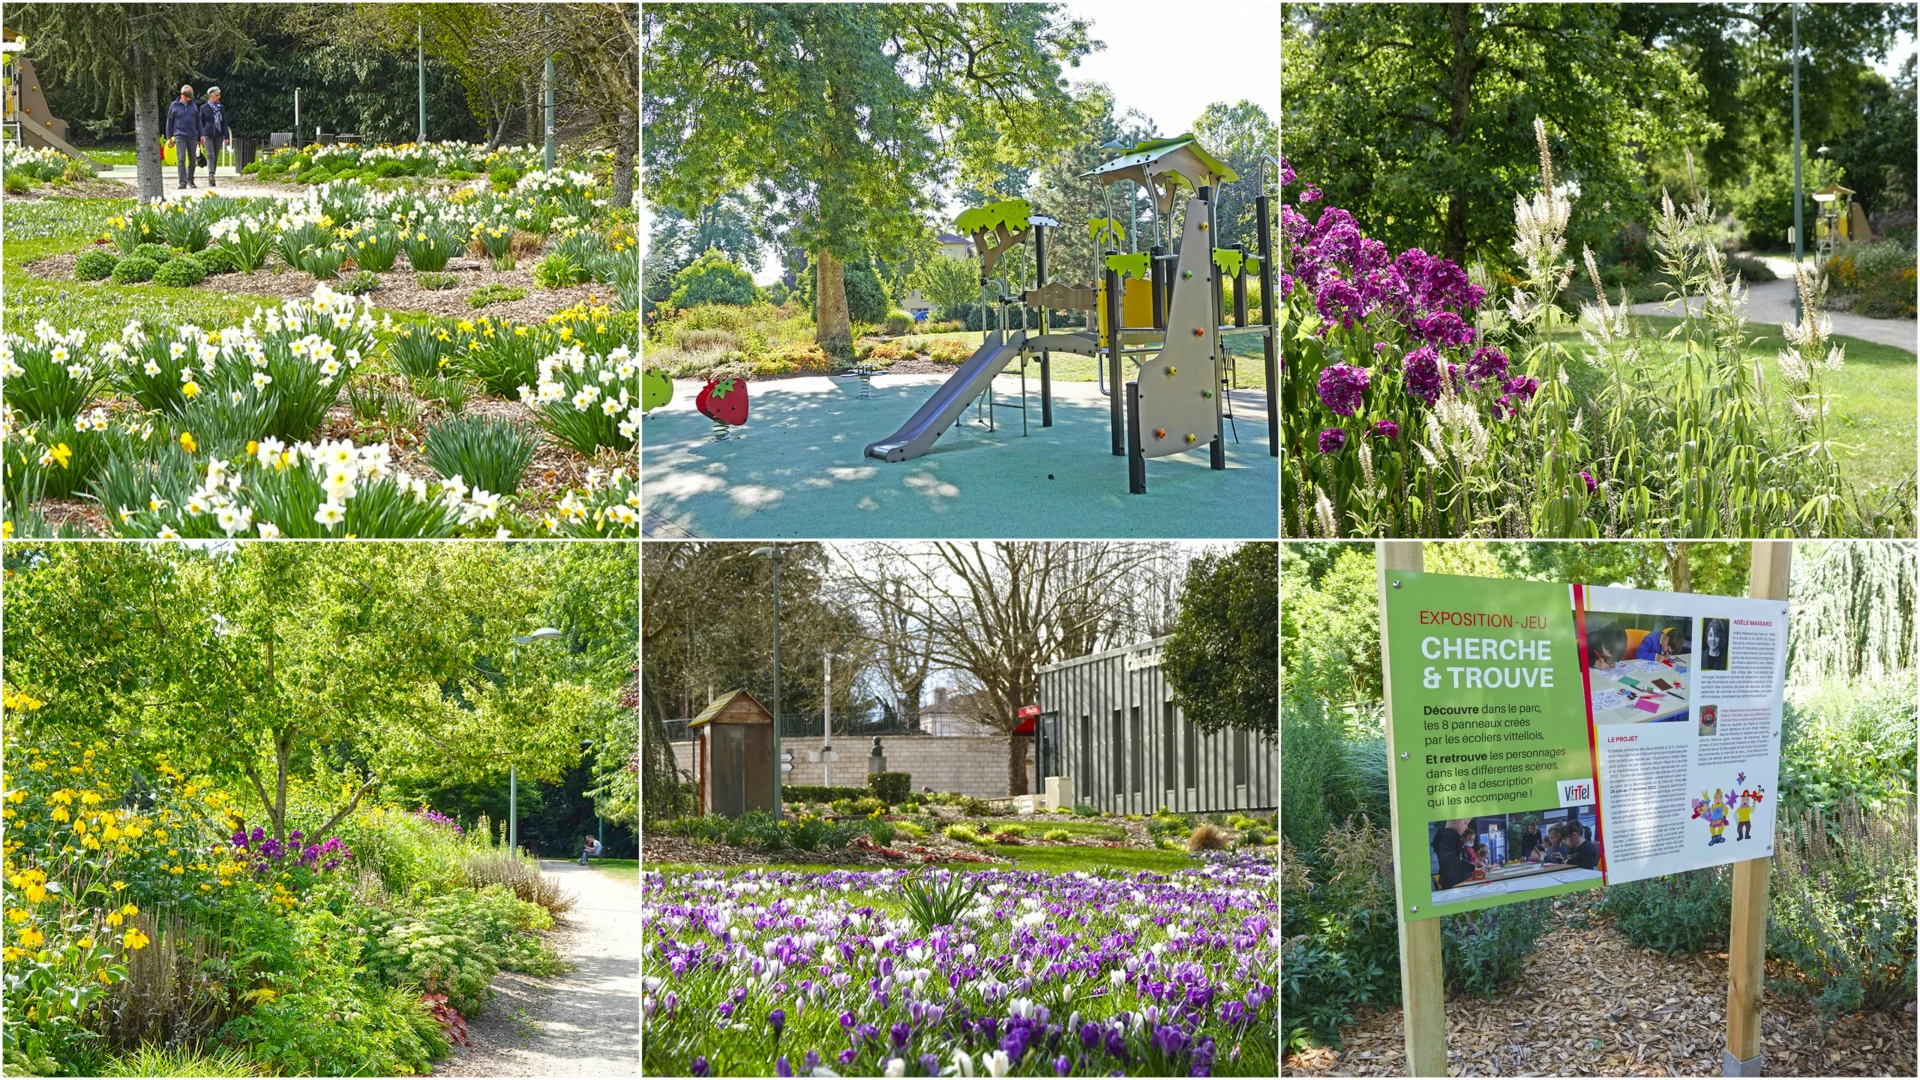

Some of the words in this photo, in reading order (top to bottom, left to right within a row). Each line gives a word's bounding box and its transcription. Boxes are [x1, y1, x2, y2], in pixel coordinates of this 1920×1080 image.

[1422, 636, 1552, 661] CHERCHE
[1423, 666, 1442, 689] &
[1447, 667, 1554, 689] TROUVE
[1424, 706, 1479, 716] Découvre
[1482, 704, 1506, 714] dans
[1509, 703, 1516, 713] le
[1519, 704, 1542, 717] parc,
[1424, 720, 1440, 730] les
[1442, 720, 1449, 730] 8
[1451, 720, 1502, 731] panneaux
[1504, 718, 1530, 727] créés
[1425, 736, 1442, 747] par
[1445, 734, 1460, 744] les
[1462, 732, 1502, 743] écoliers
[1504, 731, 1544, 742] vittellois,
[1426, 755, 1438, 764] Et
[1440, 754, 1487, 763] retrouve
[1489, 751, 1503, 760] les
[1506, 748, 1566, 763] personnages
[1426, 769, 1452, 779] dans
[1455, 767, 1470, 776] les
[1472, 764, 1523, 775] différentes
[1525, 761, 1559, 772] scènes,
[1427, 783, 1457, 796] grâce
[1459, 781, 1465, 790] à
[1468, 780, 1476, 790] la
[1478, 776, 1533, 791] description
[1427, 797, 1445, 808] qui
[1447, 796, 1462, 806] les
[1464, 791, 1527, 804] accompagne
